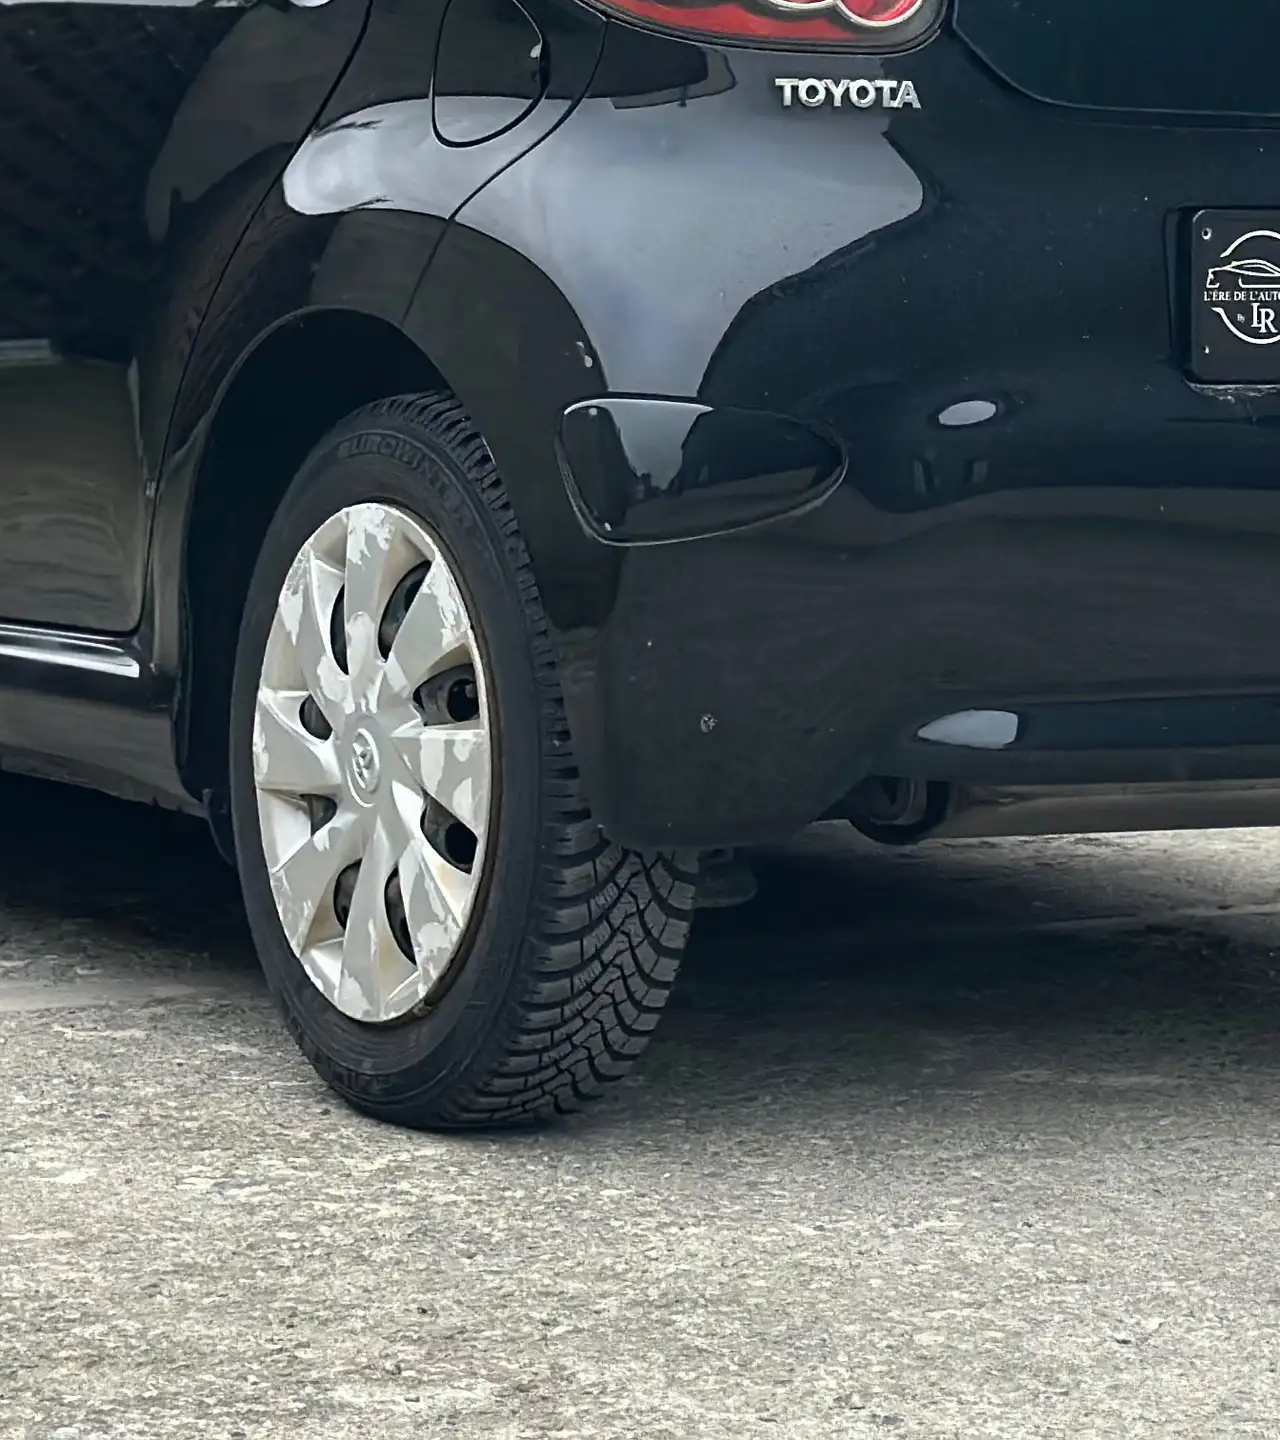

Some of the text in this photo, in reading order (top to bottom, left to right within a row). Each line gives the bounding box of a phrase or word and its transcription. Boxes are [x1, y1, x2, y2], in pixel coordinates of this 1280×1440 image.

[775, 78, 921, 109] TOYOTA
[1234, 291, 1247, 302] DE
[1251, 302, 1279, 333] LR
